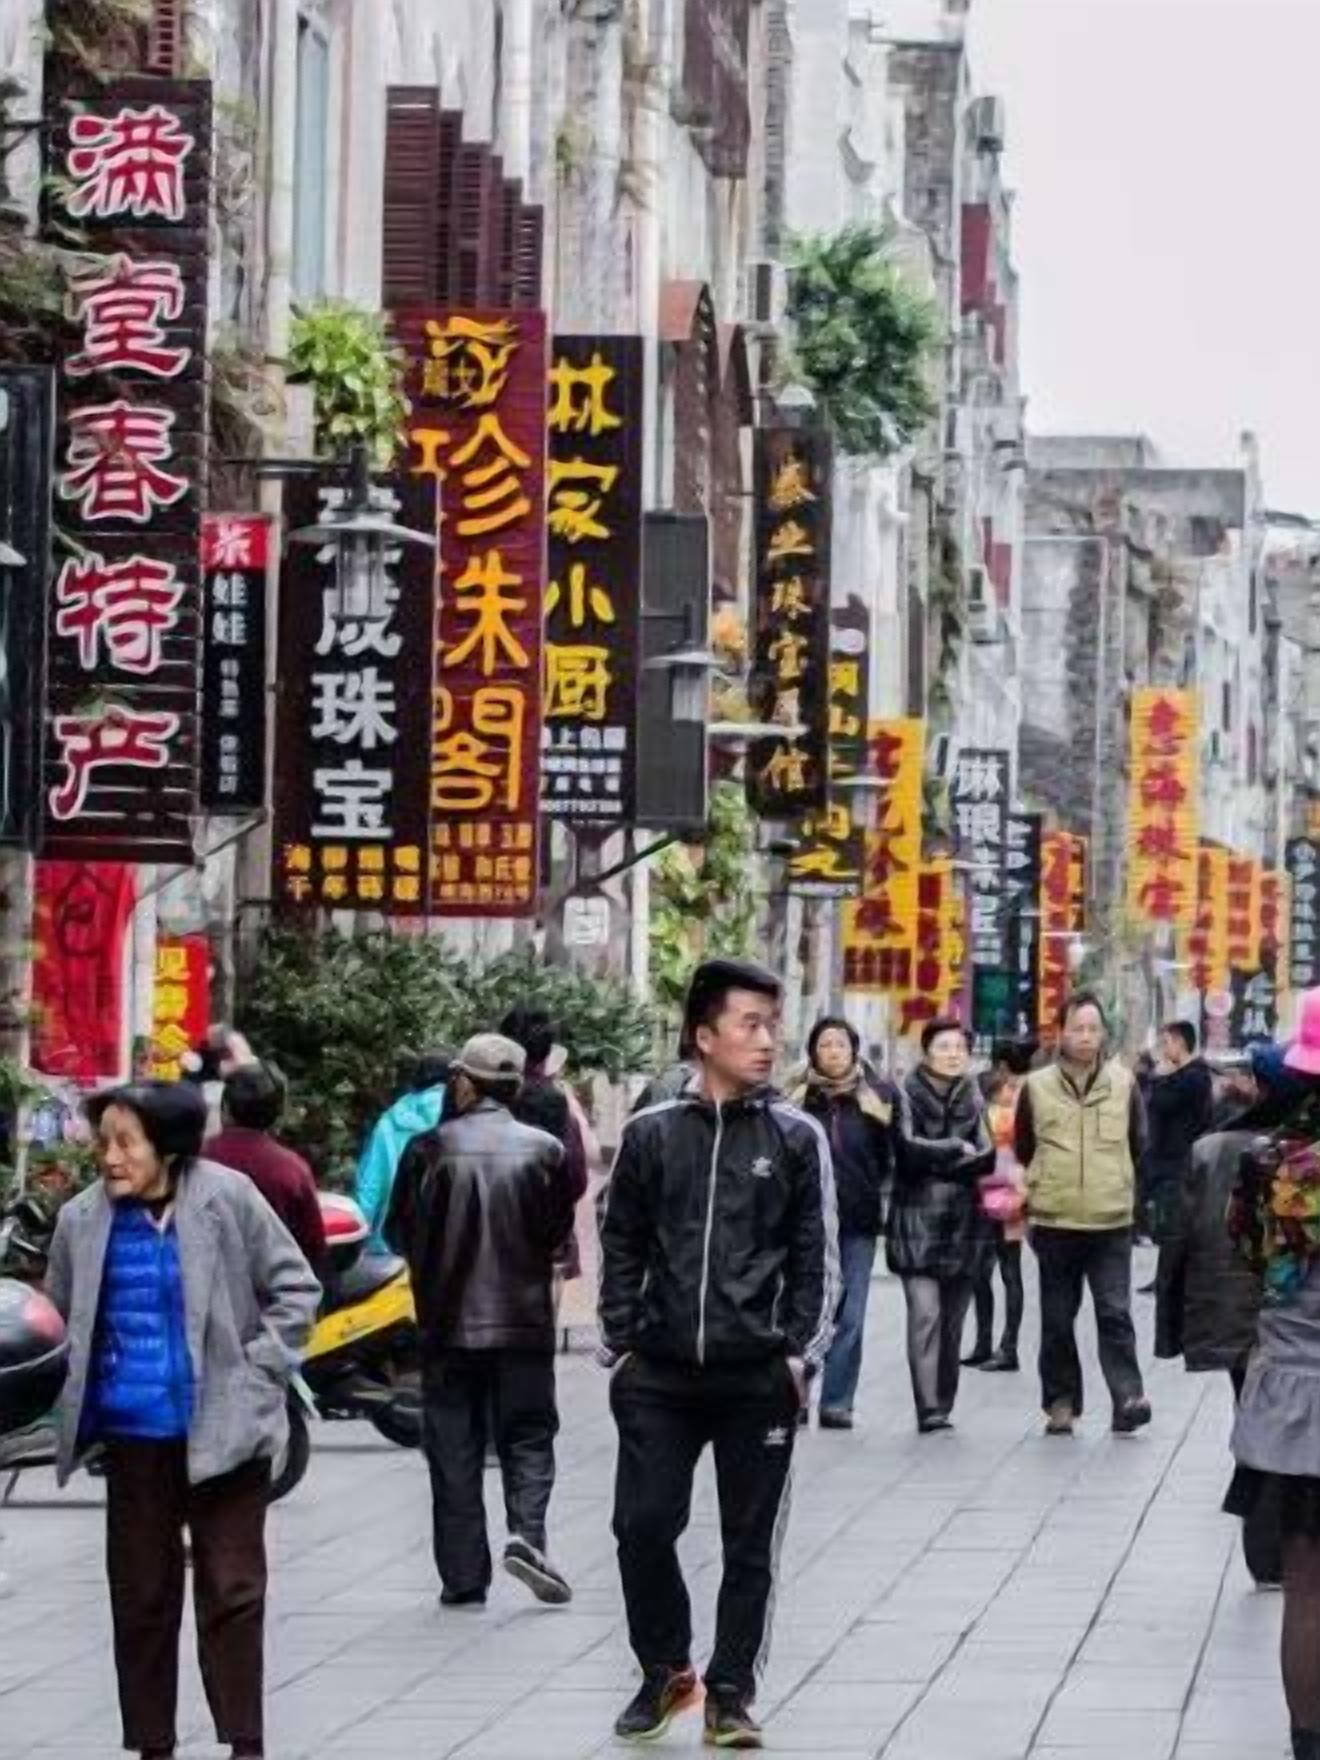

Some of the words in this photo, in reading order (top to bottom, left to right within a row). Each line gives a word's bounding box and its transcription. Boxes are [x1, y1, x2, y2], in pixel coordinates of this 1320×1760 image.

[50, 104, 194, 821] 满堂春特产
[543, 351, 622, 720] 林家小厨
[311, 487, 402, 838] 珠宝
